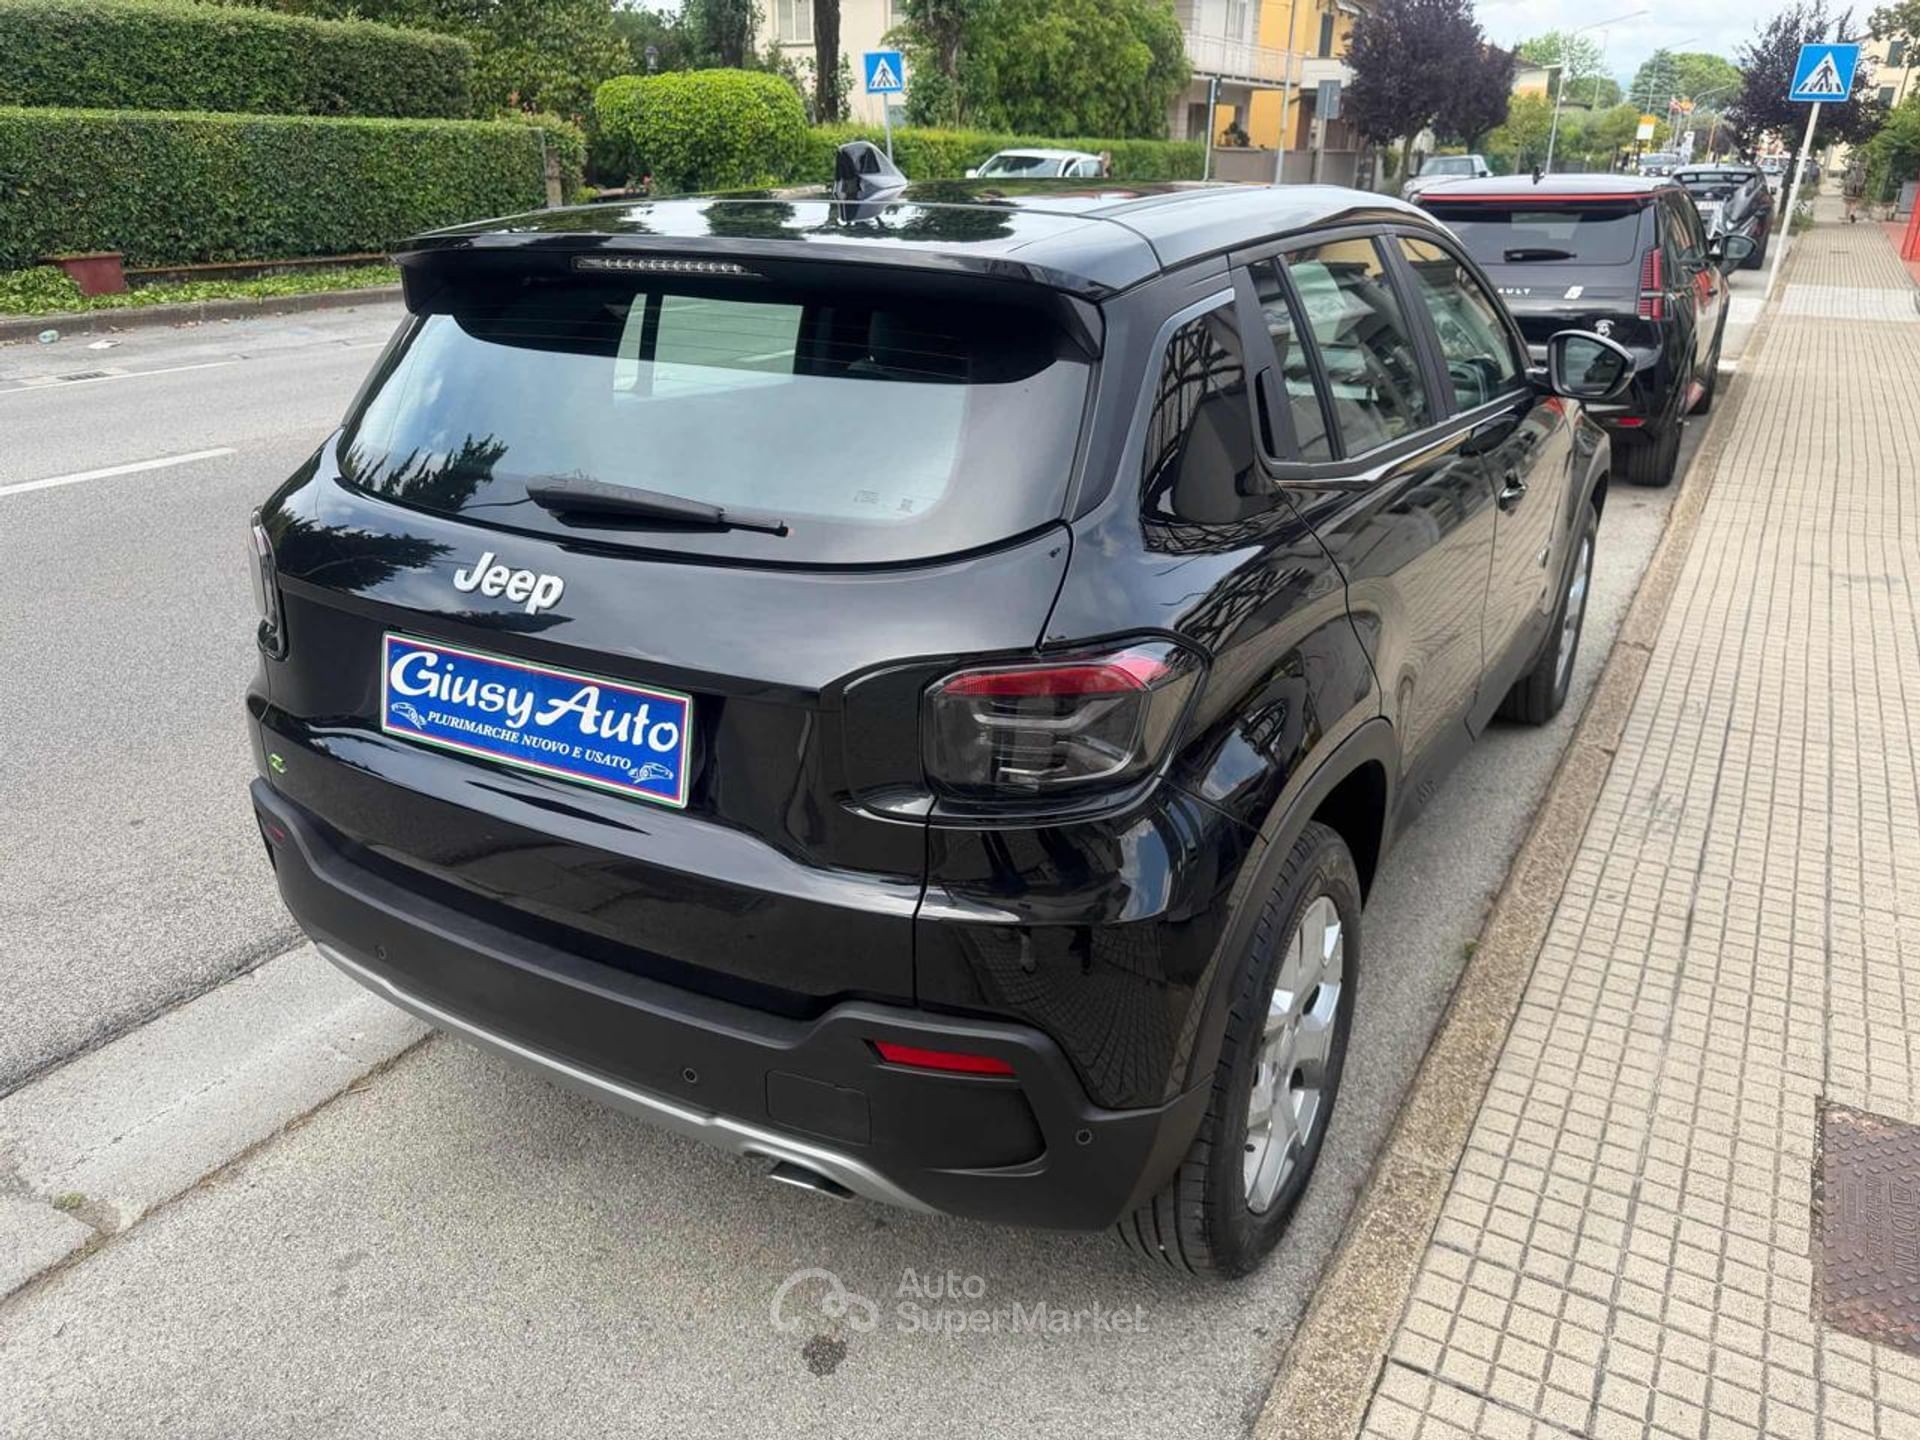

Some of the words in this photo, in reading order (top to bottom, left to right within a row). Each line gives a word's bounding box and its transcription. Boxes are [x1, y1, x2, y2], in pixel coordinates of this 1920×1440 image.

[453, 551, 565, 615] Jeep
[390, 651, 534, 729] Giusy
[535, 686, 679, 752] Auto
[427, 710, 520, 744] PLURIMARCHE
[521, 734, 570, 756] NUOVO
[571, 746, 581, 759] E
[584, 749, 632, 771] USATO
